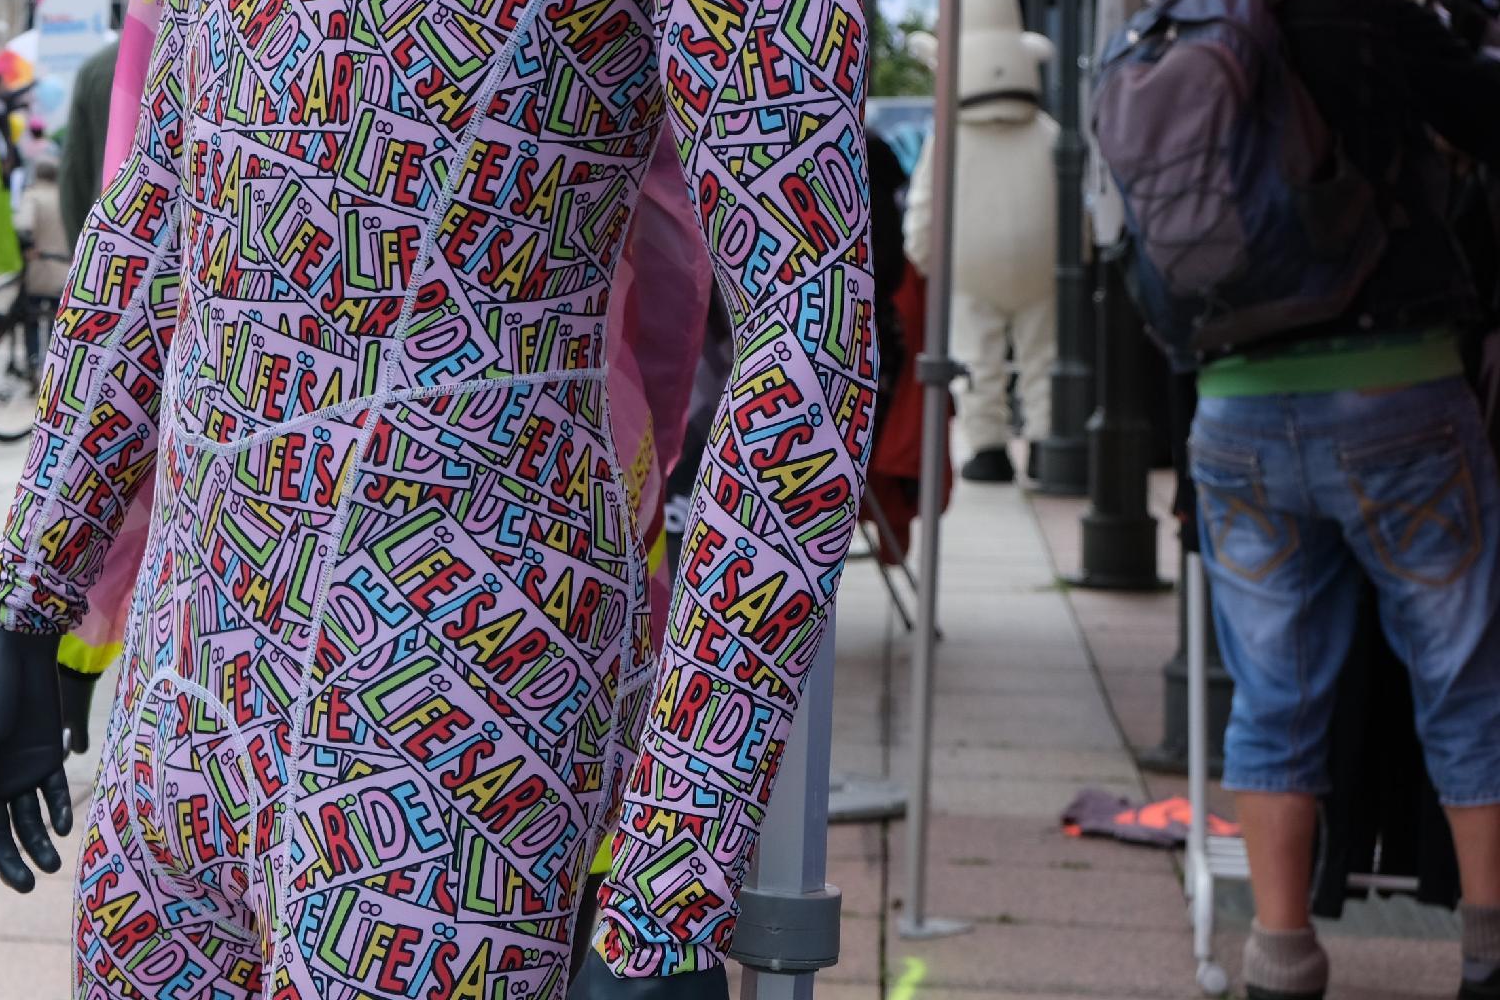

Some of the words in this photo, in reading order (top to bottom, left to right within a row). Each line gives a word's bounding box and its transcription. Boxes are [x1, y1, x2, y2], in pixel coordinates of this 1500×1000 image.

[303, 50, 327, 125] A
[526, 155, 564, 221] A
[492, 232, 539, 295] A
[565, 444, 591, 507] A
[759, 449, 837, 501] A
[543, 567, 574, 631] A
[723, 572, 787, 637] A
[456, 608, 527, 664] A
[653, 666, 680, 728] A
[452, 755, 526, 815] A
[92, 892, 140, 937] A
